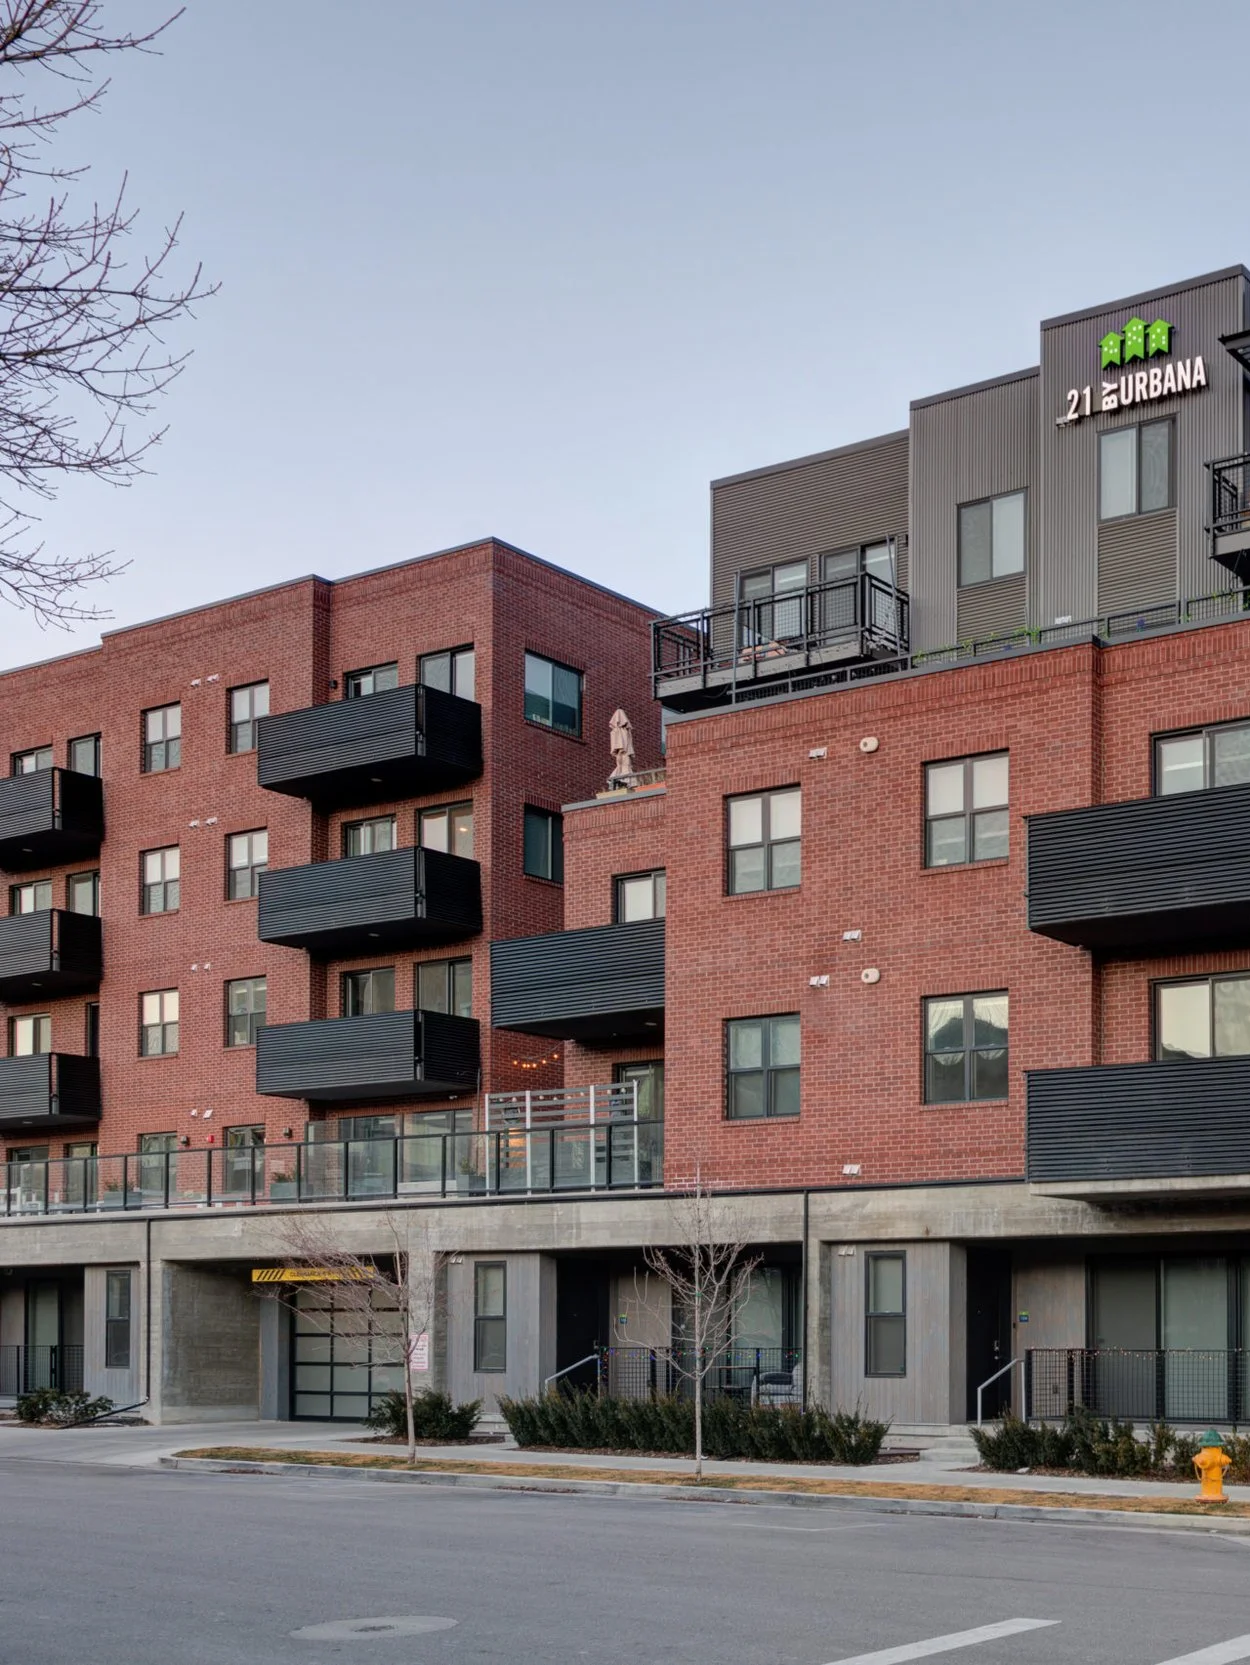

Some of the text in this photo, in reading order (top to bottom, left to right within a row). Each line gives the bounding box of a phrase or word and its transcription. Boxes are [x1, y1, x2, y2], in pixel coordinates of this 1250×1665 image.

[1066, 355, 1207, 420] 21 BY URBANA
